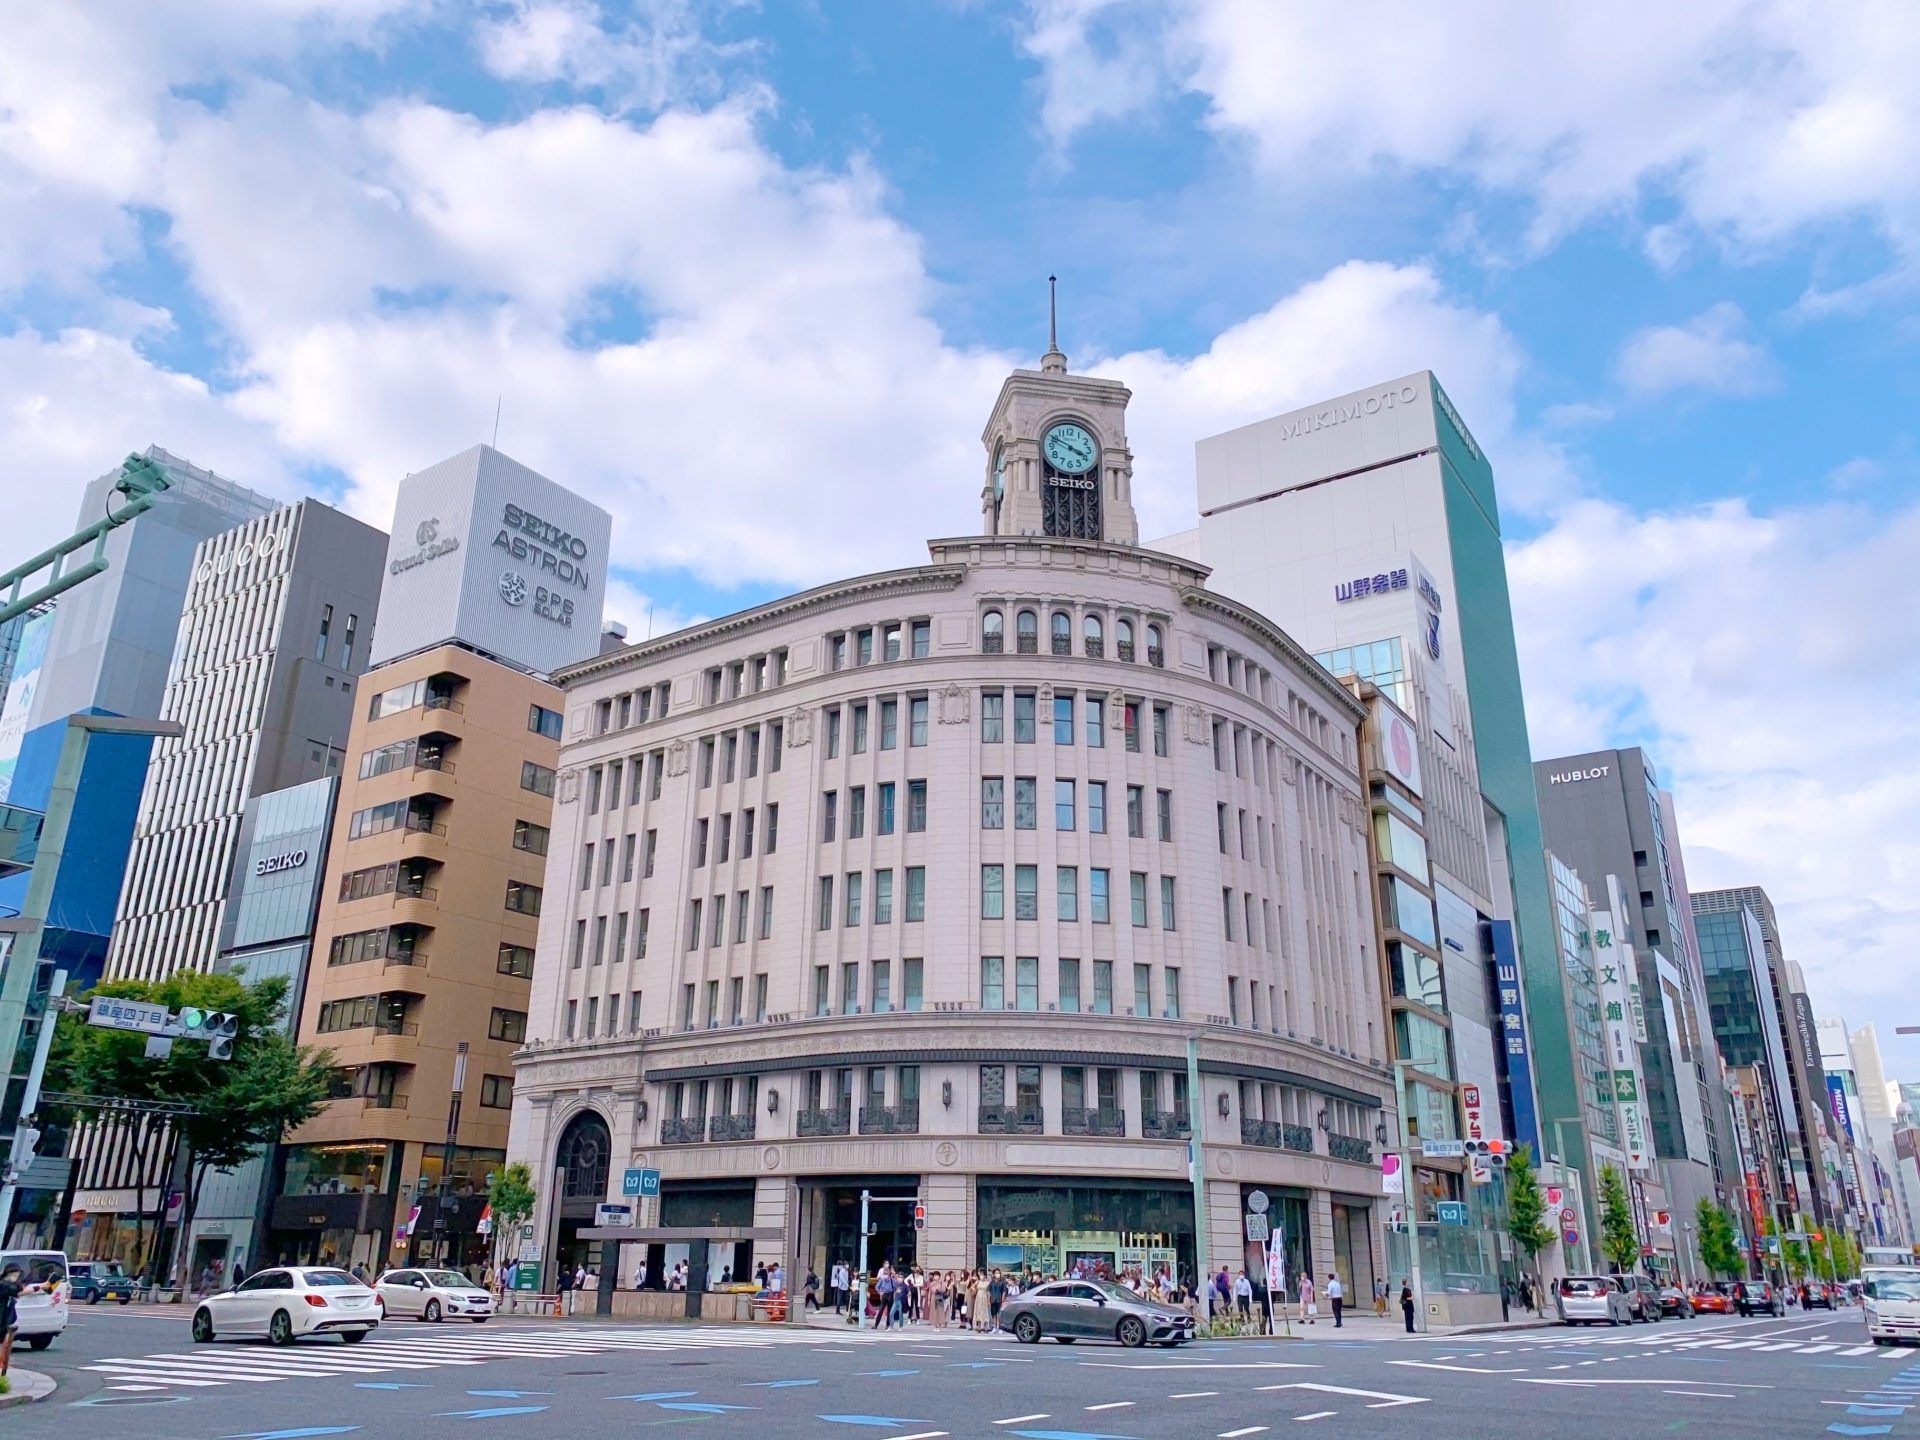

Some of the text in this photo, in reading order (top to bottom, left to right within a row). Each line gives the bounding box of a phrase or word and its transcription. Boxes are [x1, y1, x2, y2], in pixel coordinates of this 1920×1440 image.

[1281, 386, 1417, 441] MIKIMOTO
[1058, 429, 1064, 437] 11
[1077, 431, 1080, 439] 1
[1083, 437, 1088, 446] 2
[1048, 442, 1055, 450] 9
[1052, 451, 1058, 459] 8
[1086, 446, 1091, 454] 3
[1059, 457, 1065, 465] 7
[1067, 460, 1073, 468] 6
[1076, 459, 1082, 467] 5
[1050, 477, 1094, 489] SEIKO
[502, 503, 587, 560] SEIKO
[197, 527, 287, 583] GUCCI
[491, 530, 589, 590] ASTRON
[1335, 568, 1408, 602] 山野楽器
[535, 586, 574, 615] GPS
[532, 602, 572, 628] SOLAR
[1550, 766, 1609, 785] HUBLOT
[255, 850, 307, 876] SEIKO
[1595, 929, 1622, 1021] 教文館
[97, 1004, 161, 1024] 銀座四丁目
[1499, 965, 1524, 1054] 山野楽器
[1629, 983, 1645, 1038] 教文館ビル
[114, 1019, 133, 1027] Ginza
[1796, 998, 1814, 1067] Ermenegildo Zegna
[1616, 1075, 1634, 1096] 本
[1834, 1088, 1847, 1125] MIZUHO
[86, 1196, 119, 1207] GUCCI
